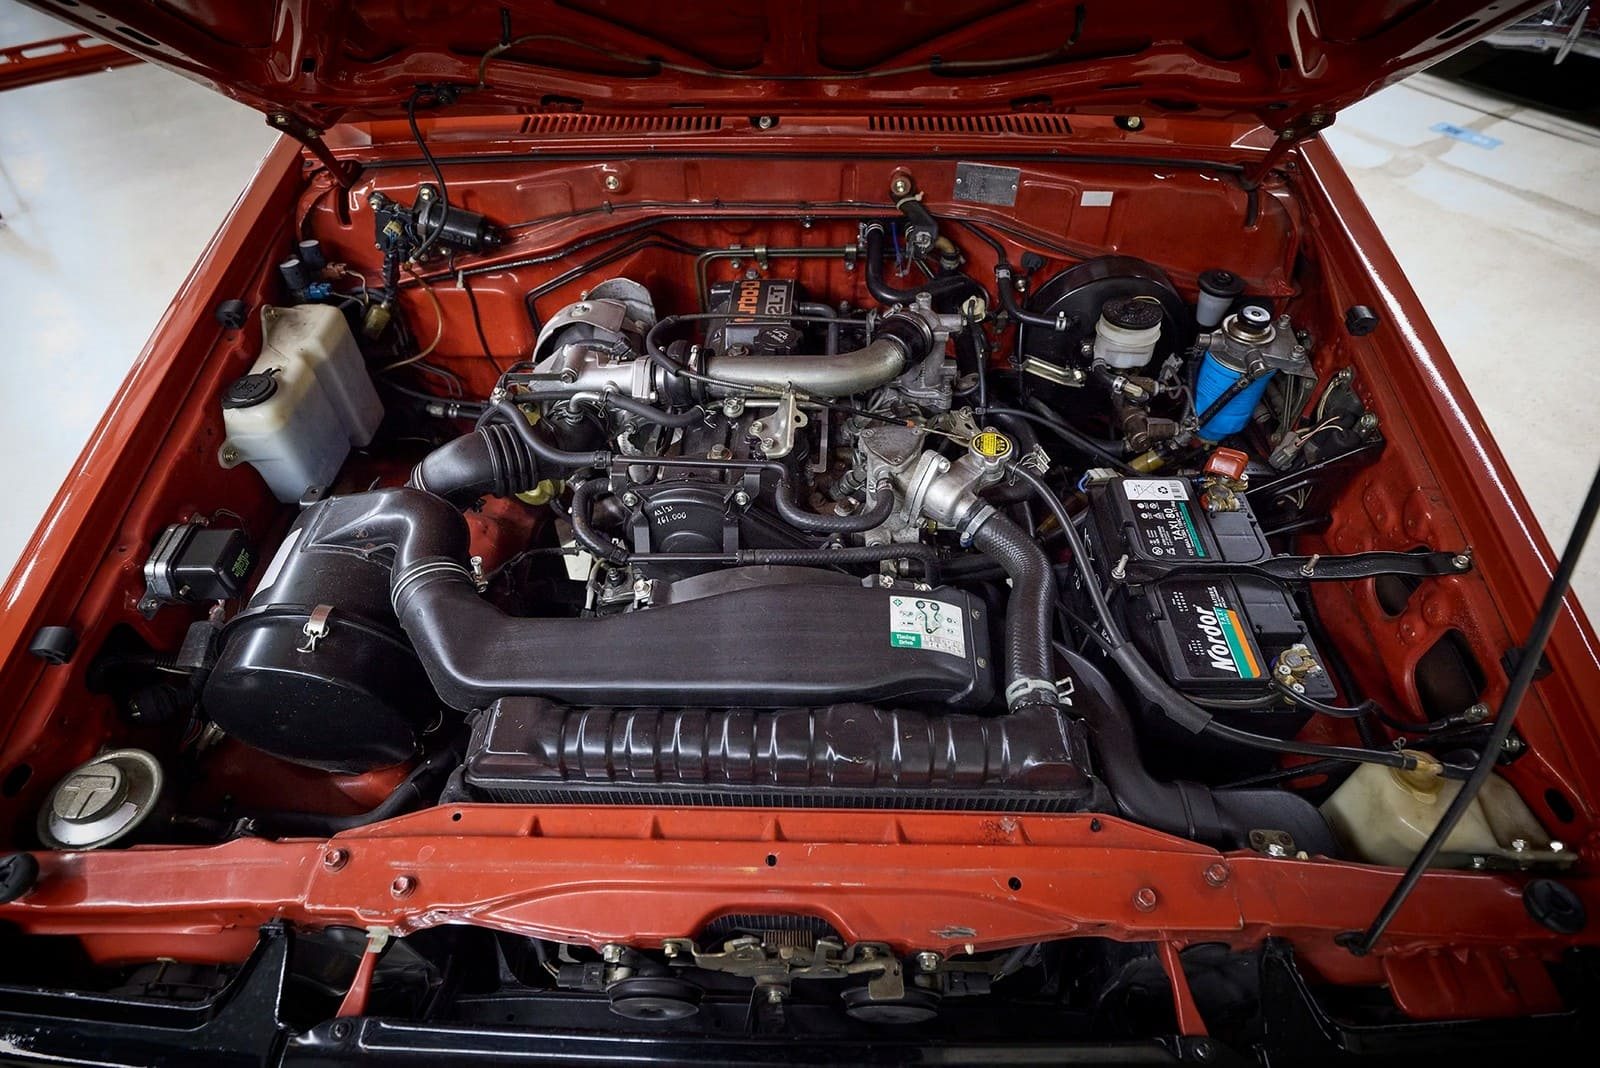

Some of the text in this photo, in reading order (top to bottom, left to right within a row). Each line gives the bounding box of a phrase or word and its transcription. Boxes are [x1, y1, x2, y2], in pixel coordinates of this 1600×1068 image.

[1163, 508, 1176, 519] 80
[1167, 520, 1184, 541] TAXI
[895, 633, 916, 641] Timing
[1193, 604, 1237, 672] Nordor
